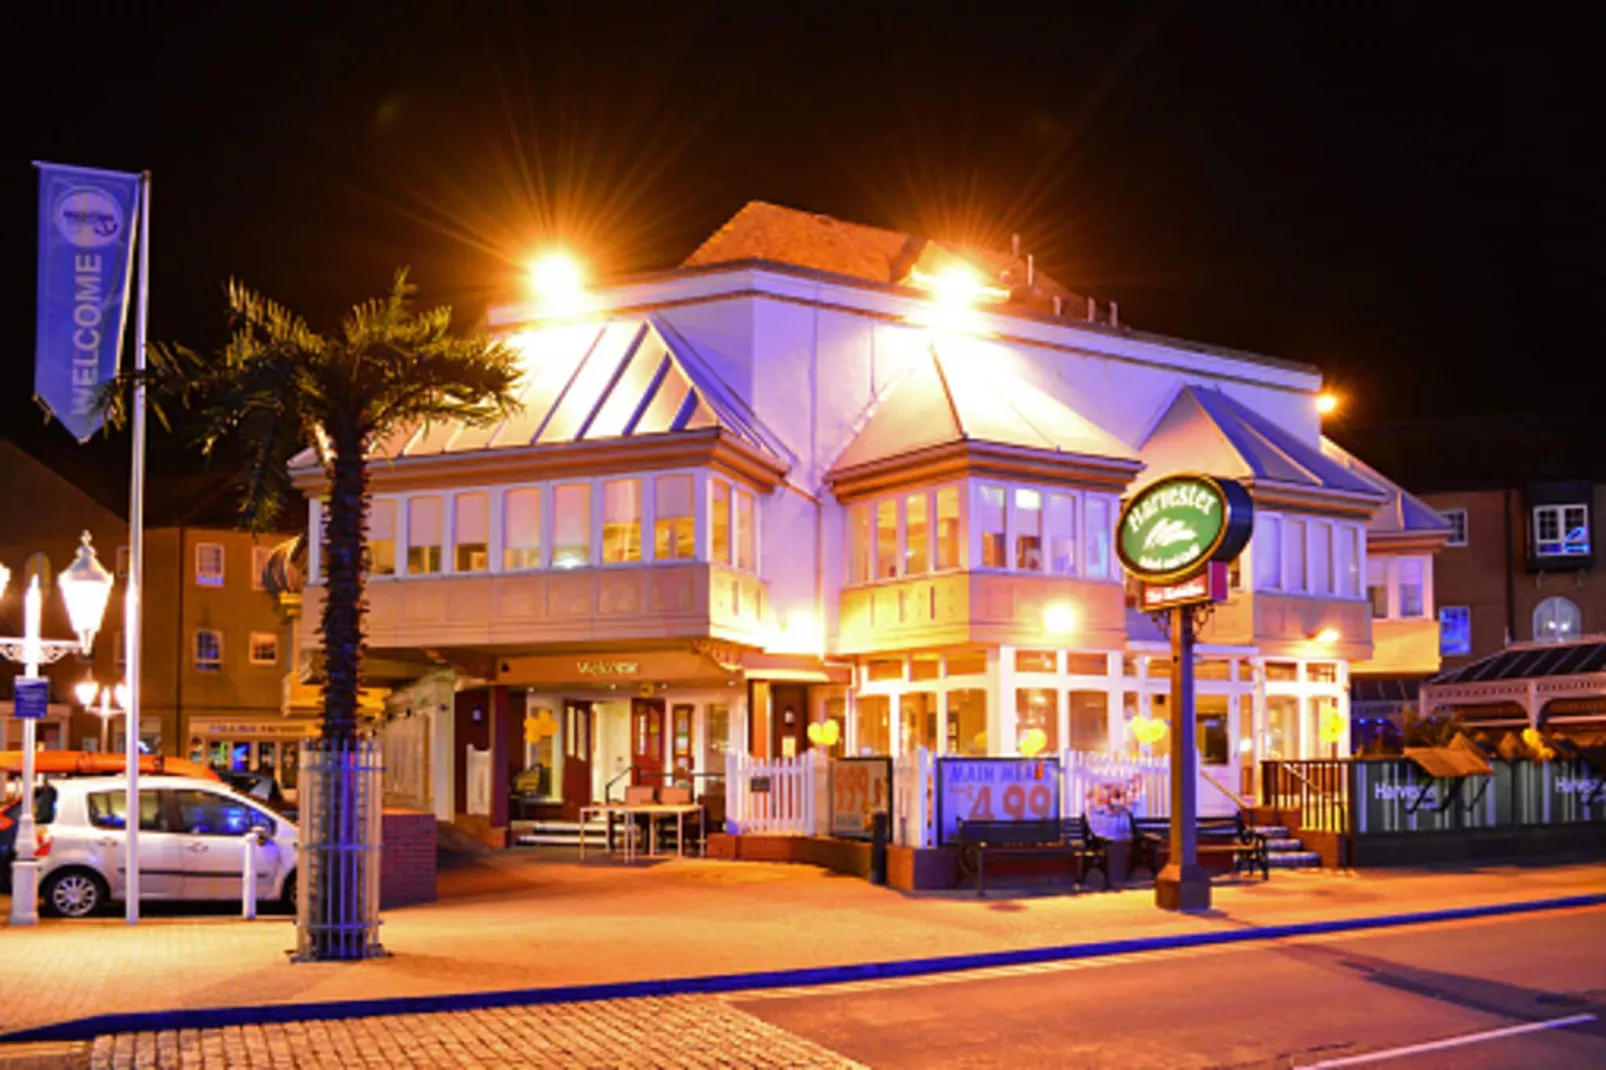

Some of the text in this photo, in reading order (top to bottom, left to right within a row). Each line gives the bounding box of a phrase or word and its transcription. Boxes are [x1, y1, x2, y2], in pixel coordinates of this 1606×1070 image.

[71, 254, 103, 415] WELCOME
[949, 763, 1052, 782] MAIN MEAS
